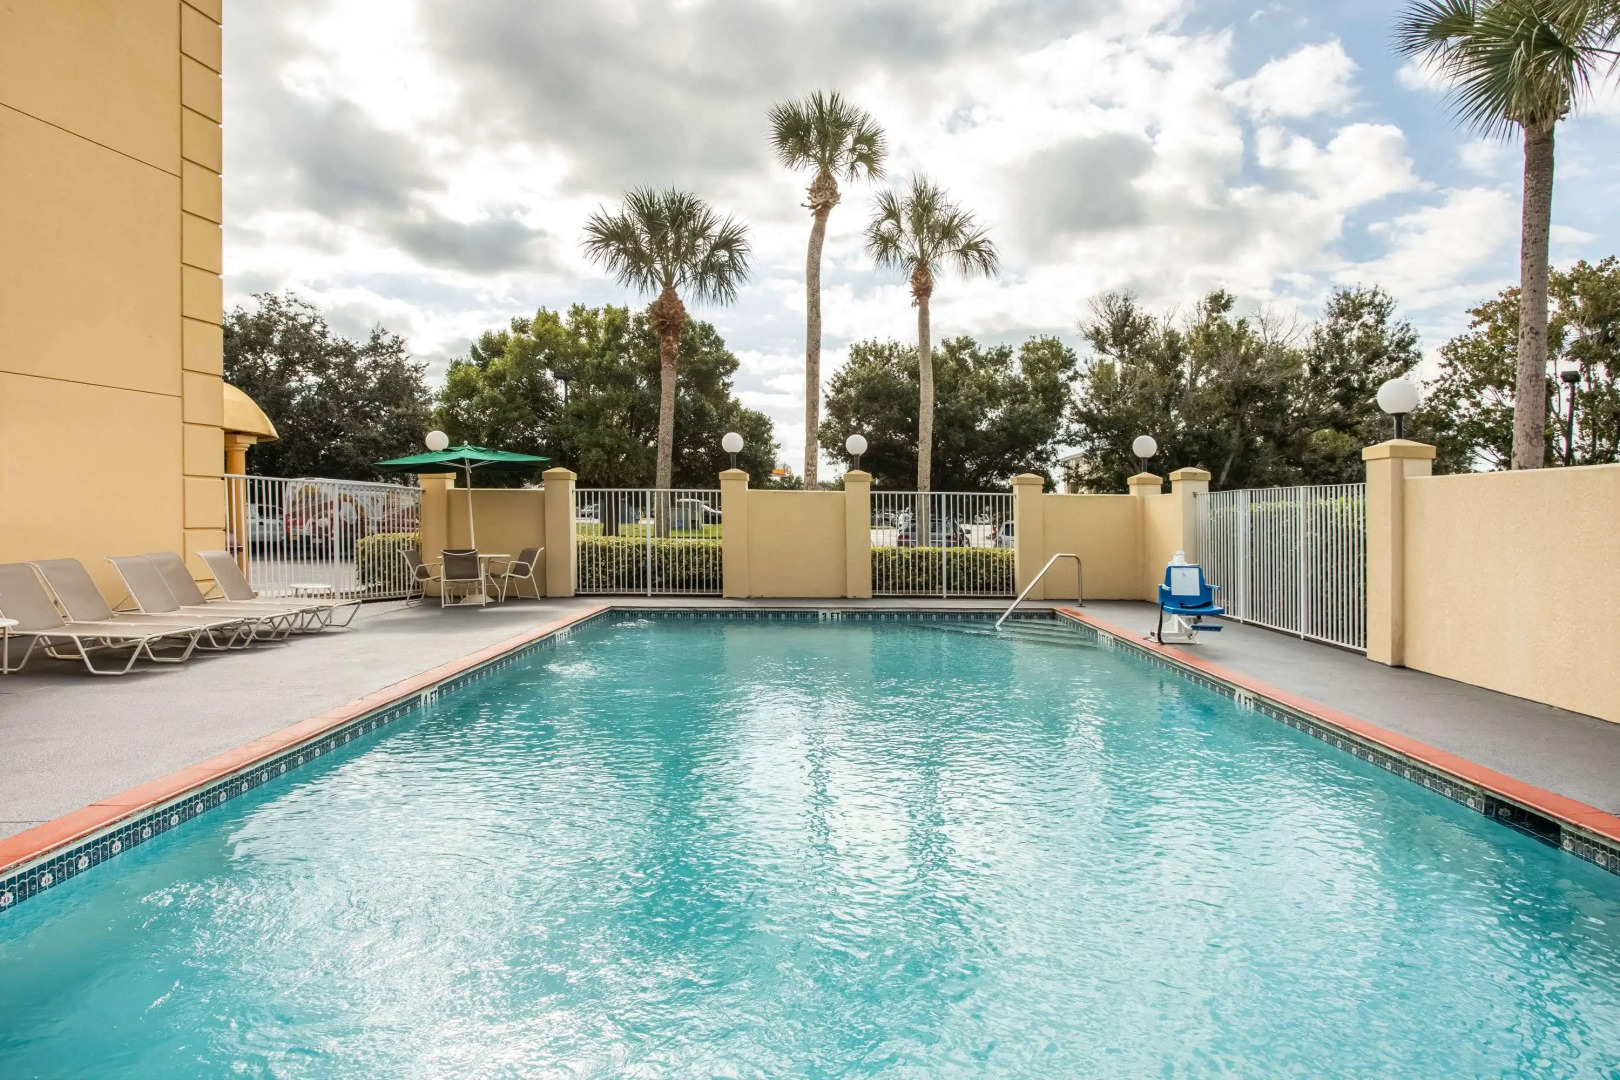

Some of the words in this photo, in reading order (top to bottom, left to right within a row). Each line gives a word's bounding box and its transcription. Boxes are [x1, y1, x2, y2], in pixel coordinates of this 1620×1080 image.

[822, 612, 827, 622] 3
[830, 612, 840, 622] FT
[430, 690, 438, 702] FT
